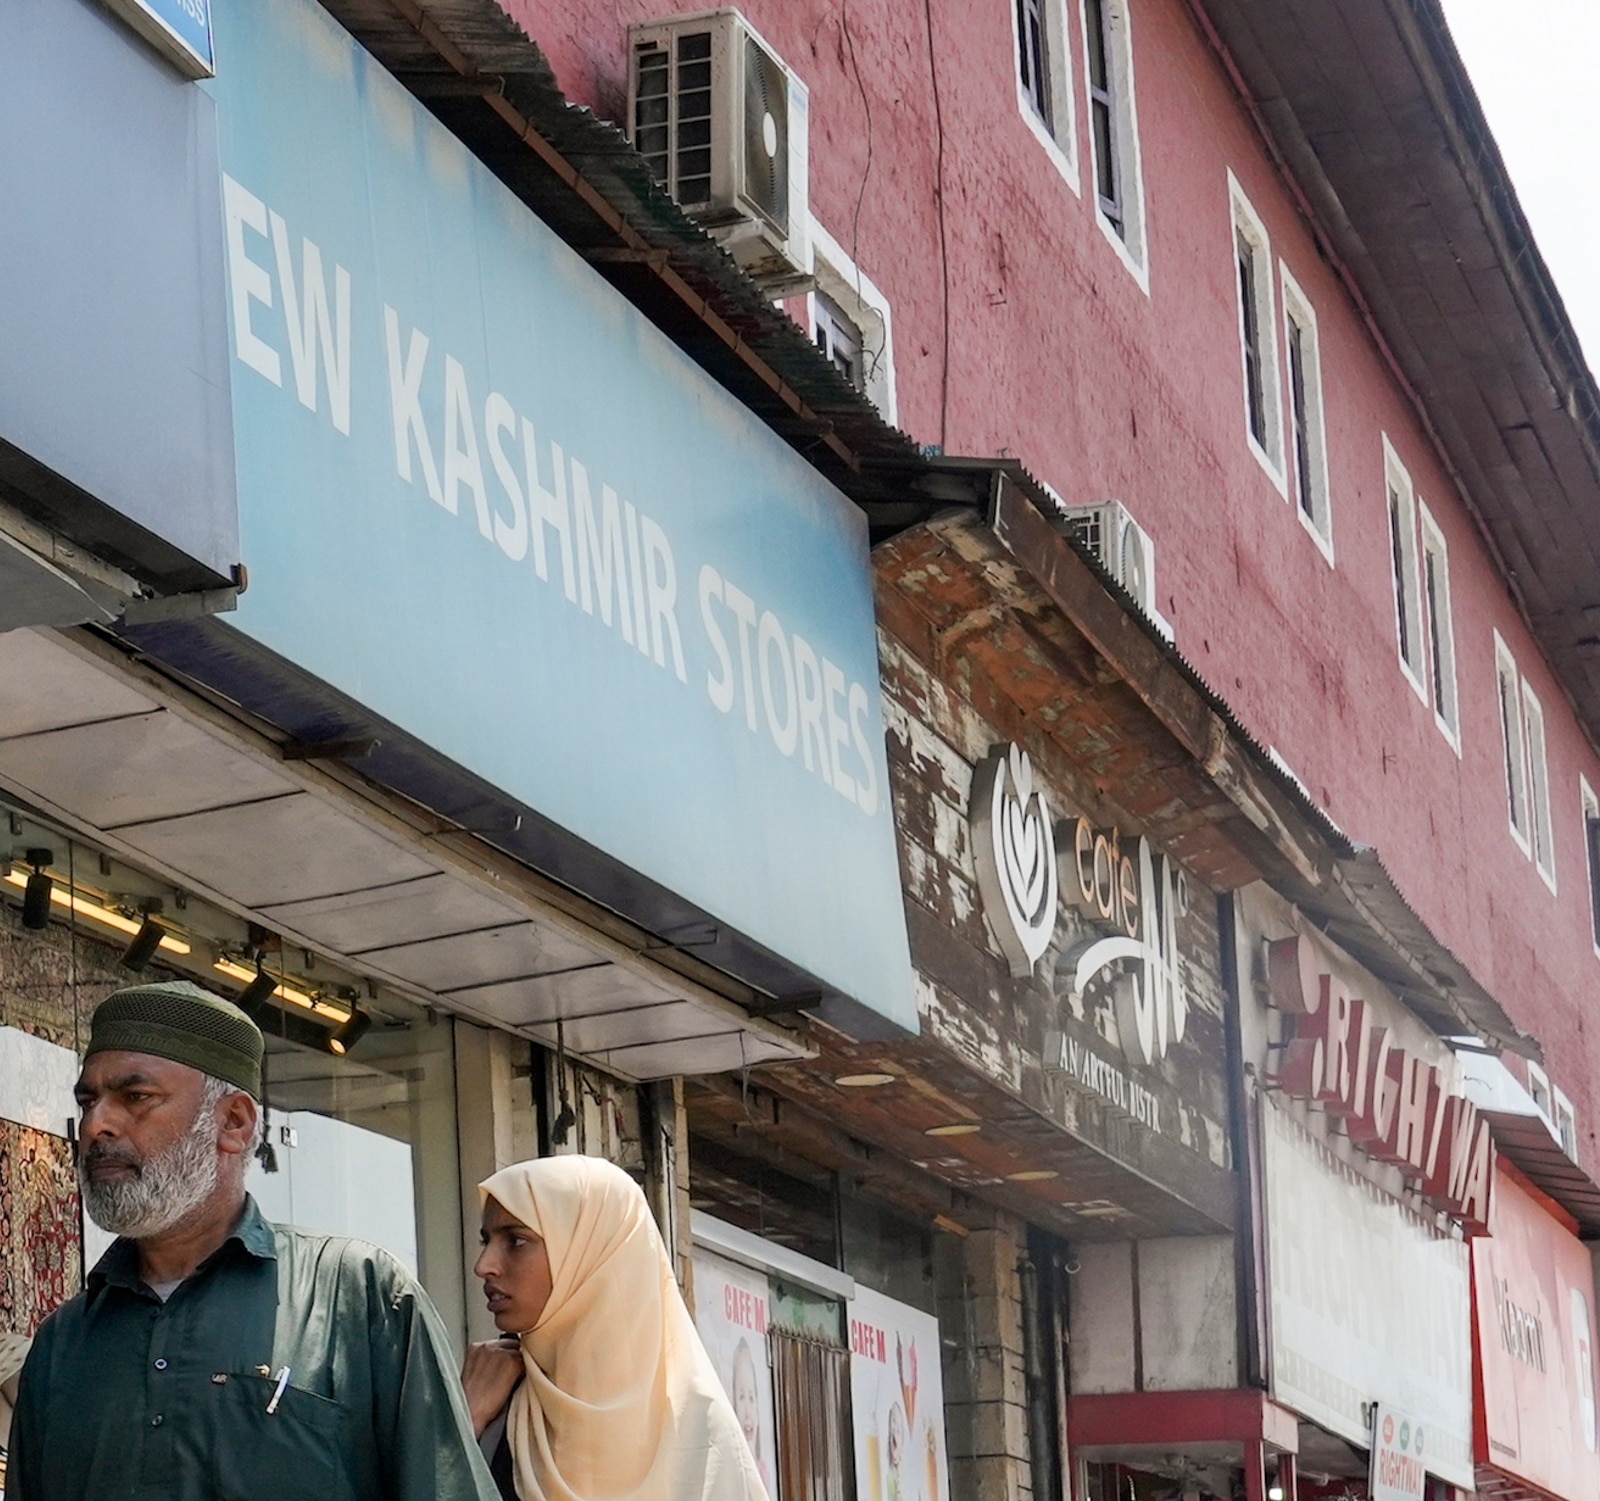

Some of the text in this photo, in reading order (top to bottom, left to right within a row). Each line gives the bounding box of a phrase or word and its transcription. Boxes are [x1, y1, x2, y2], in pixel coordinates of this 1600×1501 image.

[222, 175, 881, 816] EW KASHMIR STORES
[724, 1283, 752, 1330] CAFE
[851, 1318, 875, 1361] CAFE
